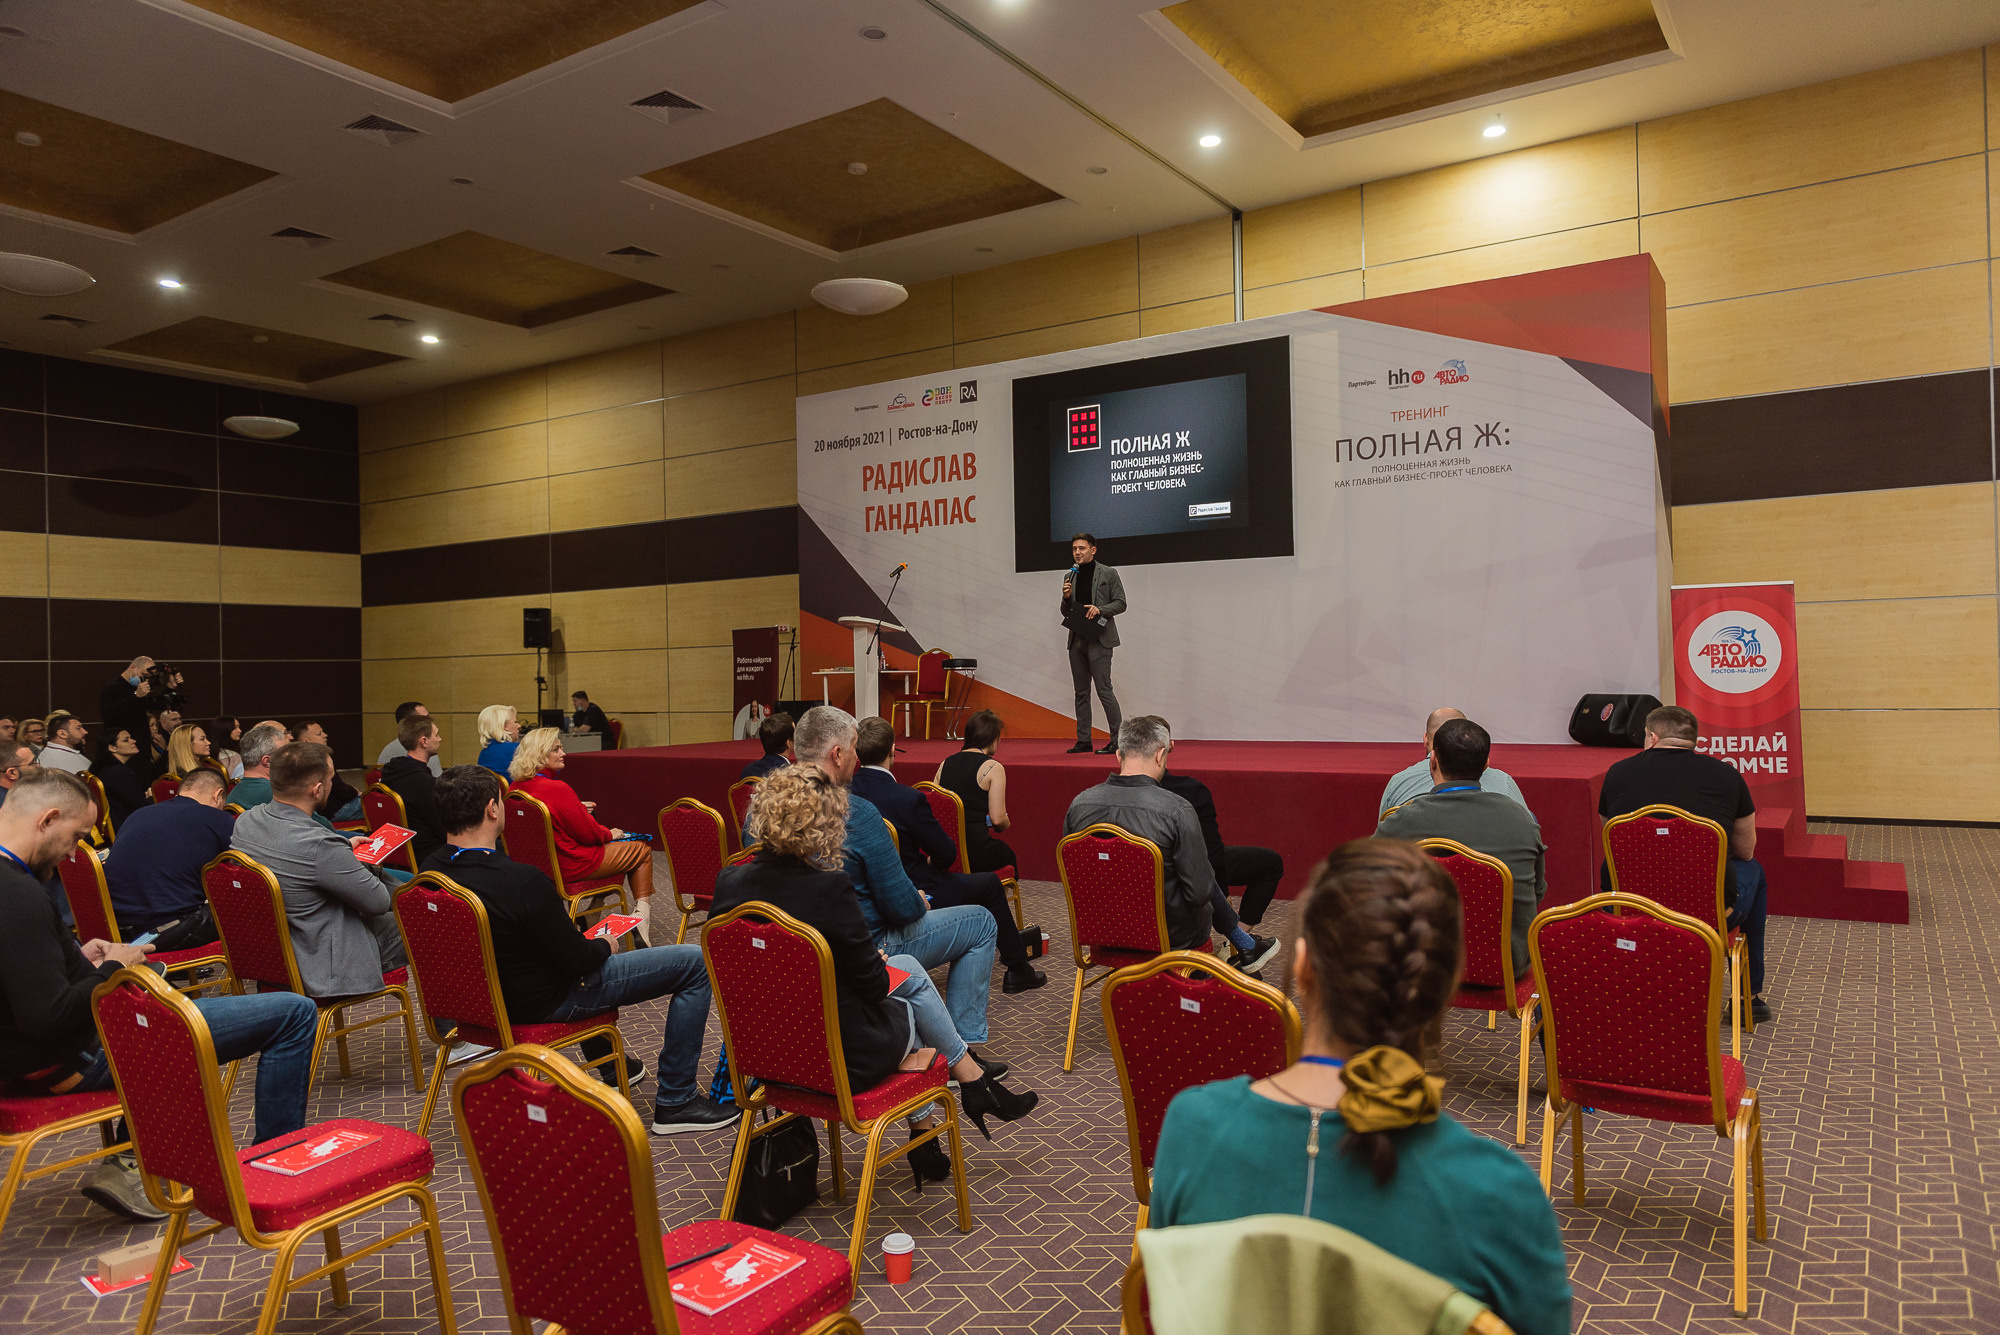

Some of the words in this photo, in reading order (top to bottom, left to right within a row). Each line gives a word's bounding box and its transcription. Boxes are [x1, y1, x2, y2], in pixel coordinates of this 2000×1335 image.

[1388, 368, 1410, 385] hh
[1433, 369, 1456, 380] АВТО
[1440, 374, 1470, 385] РАДИО
[1390, 405, 1449, 422] ТРЕНИНГ
[814, 440, 825, 452] 20
[826, 436, 860, 451] ноября
[863, 431, 885, 446] 2021
[899, 419, 978, 440] Ростов-на-Дону
[1111, 433, 1170, 455] ПОЛНАЯ
[1176, 430, 1190, 448] Ж
[1336, 426, 1462, 462] ПОЛНАЯ
[1474, 422, 1510, 449] Ж:
[1111, 454, 1170, 470] ПОЛНОЦЕННАЯ
[1172, 451, 1202, 462] ЖИЗНЬ
[1371, 459, 1438, 473] ПОЛНОЦЕННАЯ
[1439, 457, 1471, 467] ЖИЗНЬ
[862, 452, 977, 494] РАДИСЛАВ
[1111, 472, 1127, 482] КАК
[1129, 465, 1167, 480] ГЛАВНЫЙ
[1170, 464, 1204, 476] БИЗНЕС-
[1334, 479, 1350, 488] КАК
[1352, 474, 1392, 487] ГЛАВНЫЙ
[1394, 468, 1463, 483] БИЗНЕС-ПРОЕКТ
[1466, 464, 1512, 476] ЧЕЛОВЕКА
[1111, 482, 1142, 494] ПРОЕКТ
[1144, 478, 1186, 490] ЧЕЛОВЕКА
[865, 495, 976, 535] ГАНДАПАС
[1698, 643, 1742, 656] АВТО
[1711, 655, 1767, 668] РАДИО
[1694, 732, 1787, 755] СДЕЛАЙ
[1721, 757, 1788, 773] ОМЧЕ
